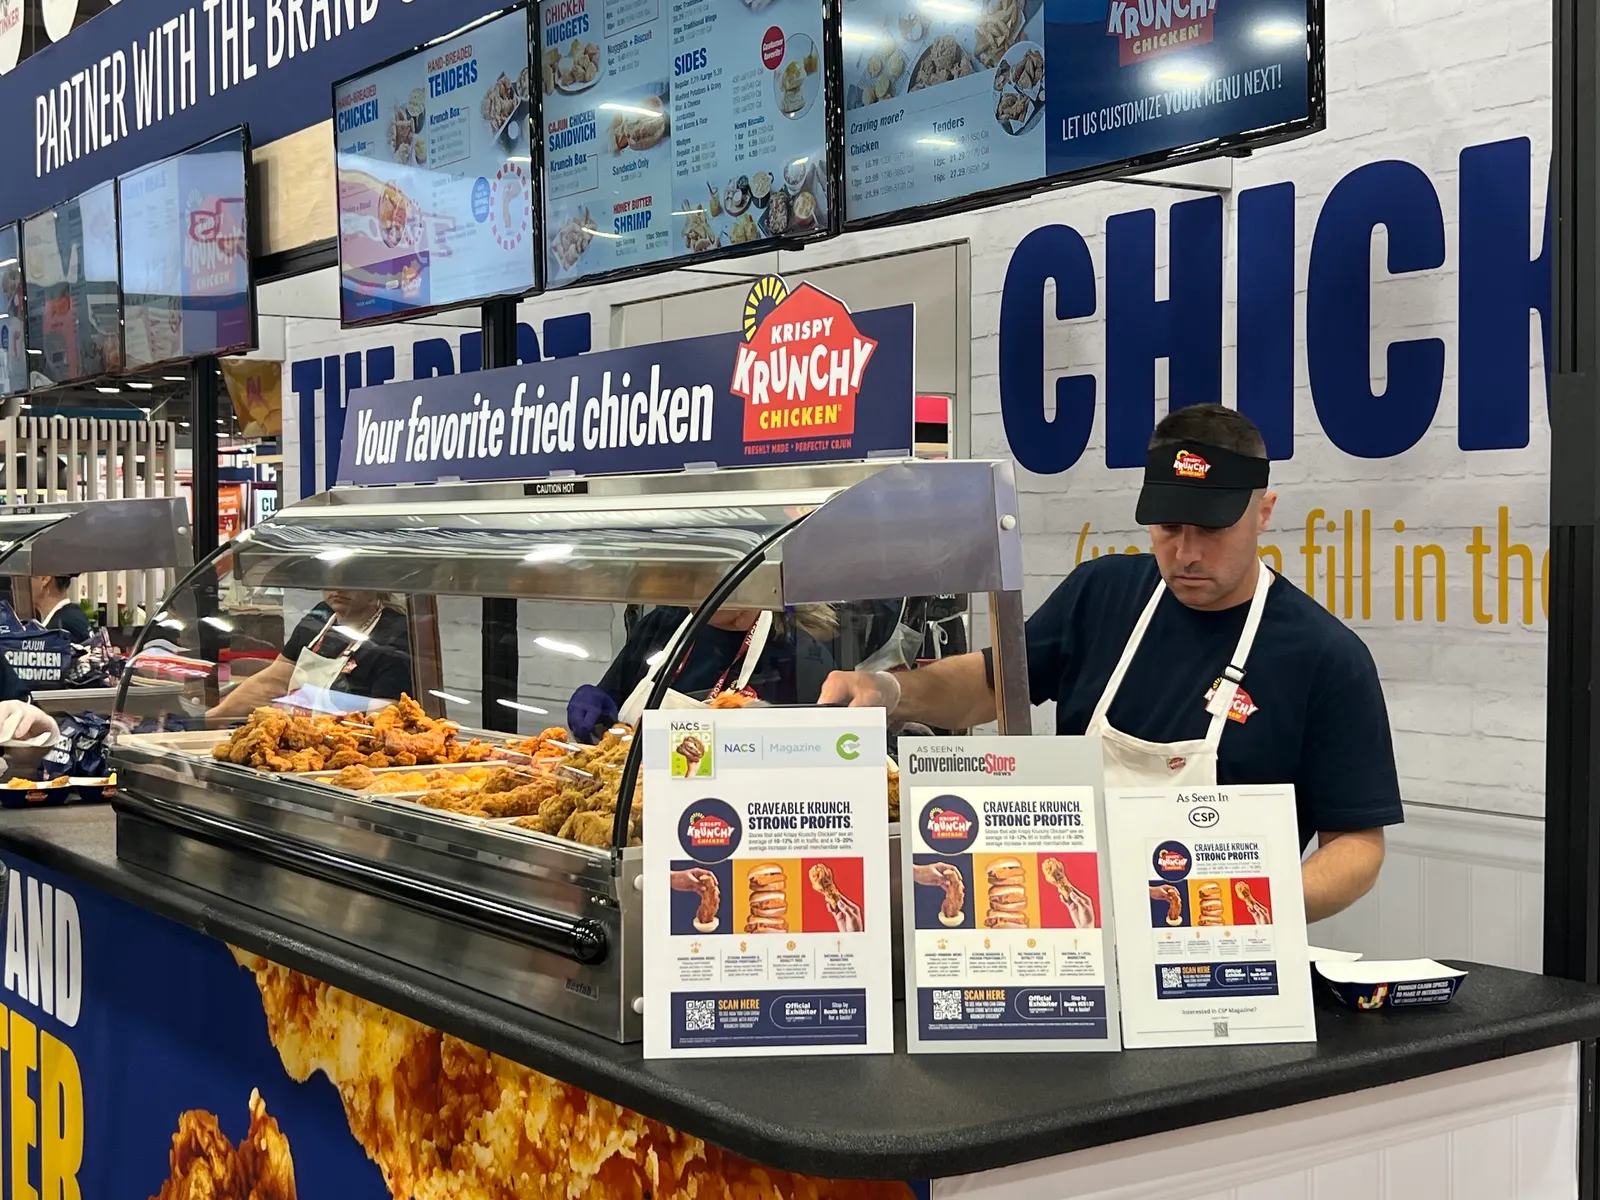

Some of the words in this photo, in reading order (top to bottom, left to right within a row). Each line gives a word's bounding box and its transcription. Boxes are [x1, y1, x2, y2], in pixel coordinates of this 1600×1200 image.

[546, 13, 589, 47] NUGGETS
[607, 39, 628, 54] Nuggets
[634, 29, 652, 45] Biscuit
[427, 44, 473, 73] HAND-BREADED
[674, 47, 707, 76] SIDES
[428, 59, 478, 98] TENDERS
[36, 49, 129, 179] PARTNER
[132, 8, 197, 131] WITH
[203, 0, 258, 97] THE
[690, 86, 707, 97] Potatoes
[1062, 115, 1081, 141] LET
[1082, 111, 1097, 136] US
[1099, 94, 1163, 132] CUSTOMIZE
[1164, 87, 1203, 117] YOUR
[1203, 77, 1241, 107] MENU
[1244, 63, 1282, 97] NEXT!
[338, 98, 379, 133] CHICKEN
[430, 110, 449, 126] Krunch
[449, 106, 460, 119] Box
[548, 117, 568, 134] CAJUN
[569, 109, 596, 128] CHICKEN
[850, 118, 878, 134] Craving
[880, 109, 905, 127] more?
[932, 117, 965, 133] Tenders
[549, 122, 596, 152] SANDWICH
[850, 140, 880, 155] Chicken
[550, 157, 573, 172] Krunch
[573, 153, 587, 164] Box
[612, 163, 637, 176] Sandwich
[637, 158, 650, 170] Only
[613, 200, 631, 214] HONEY
[631, 195, 652, 210] BUTTER
[613, 210, 652, 235] SHRIMP
[771, 316, 834, 345] KRISPY
[733, 337, 874, 405] KRUNCHY
[355, 406, 402, 466] Your
[404, 390, 505, 462] favorite
[511, 372, 576, 457] fried
[582, 364, 714, 450] chicken
[744, 444, 770, 455] FRESHLY
[772, 442, 790, 453] MADE
[795, 440, 829, 453] PERFECTLY
[831, 438, 852, 449] CAJUN
[1173, 459, 1211, 472] KRUNCHY
[536, 484, 562, 494] CAUTION
[562, 483, 575, 493] HOT
[1301, 507, 1372, 620] fill
[1394, 519, 1447, 622] in
[22, 640, 46, 651] CAJUN
[5, 651, 61, 668] CHICKEN
[671, 722, 700, 731] NACS
[724, 743, 756, 753] NACS
[769, 743, 822, 755] Magazine
[1176, 794, 1190, 803] As
[1191, 793, 1216, 802] Seen
[1218, 793, 1229, 802] In
[747, 802, 805, 815] CRAVEABLE
[807, 801, 853, 814] KRUNCH.
[983, 801, 1037, 813] CRAVEABLE
[1040, 801, 1083, 812] KRUNCH.
[748, 816, 797, 830] STRONG
[800, 815, 853, 829] PROFITS.
[984, 814, 1030, 826] STRONG
[1033, 814, 1084, 826] PROFITS.
[1192, 812, 1215, 822] CSP
[687, 825, 735, 839] KRUNCHY
[927, 819, 972, 834] KRUNCHY
[1194, 843, 1230, 852] CRAVEABLE
[1195, 852, 1226, 861] STRONG
[5, 868, 83, 1027] AND
[964, 990, 985, 1001] SCAN
[986, 990, 1005, 1000] HERE
[718, 999, 739, 1011] SCAN
[740, 999, 760, 1010] HERE
[785, 1008, 817, 1016] Exhibitor
[1228, 1006, 1257, 1014] Magazine?
